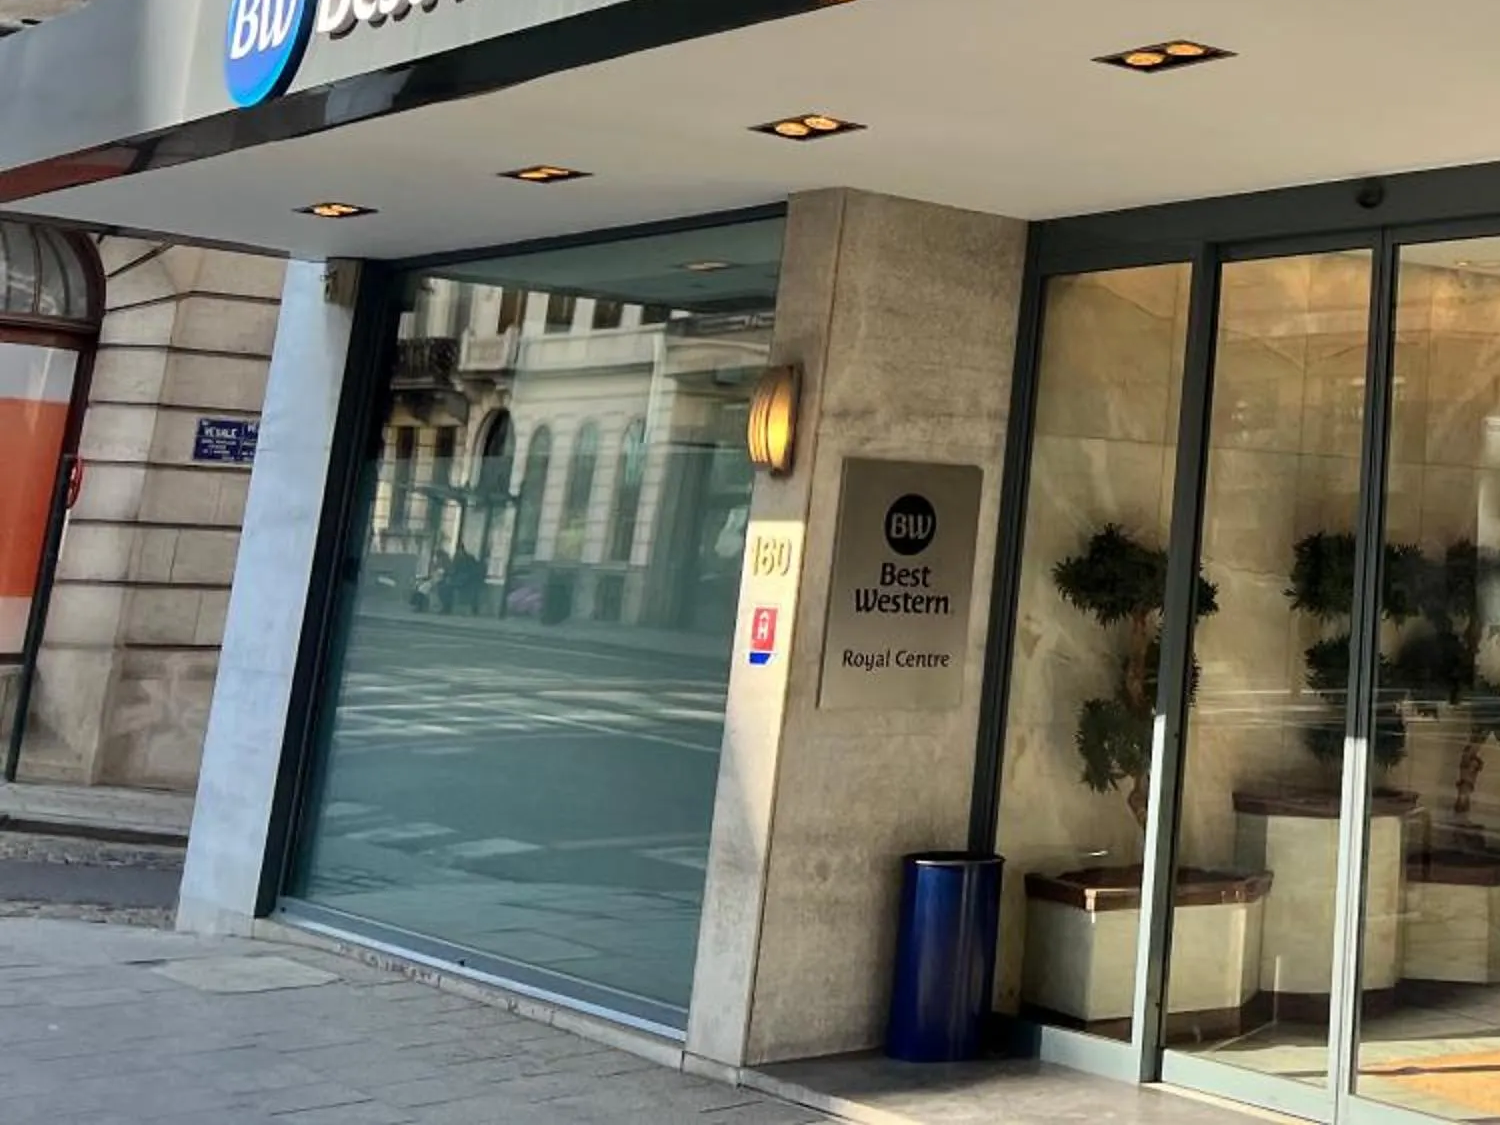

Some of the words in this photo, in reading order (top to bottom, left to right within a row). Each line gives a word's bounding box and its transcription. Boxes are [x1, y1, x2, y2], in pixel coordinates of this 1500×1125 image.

[889, 512, 933, 540] BW
[879, 562, 932, 587] Best
[855, 589, 950, 614] Western
[842, 648, 890, 671] Royal
[895, 649, 950, 668] Centre
